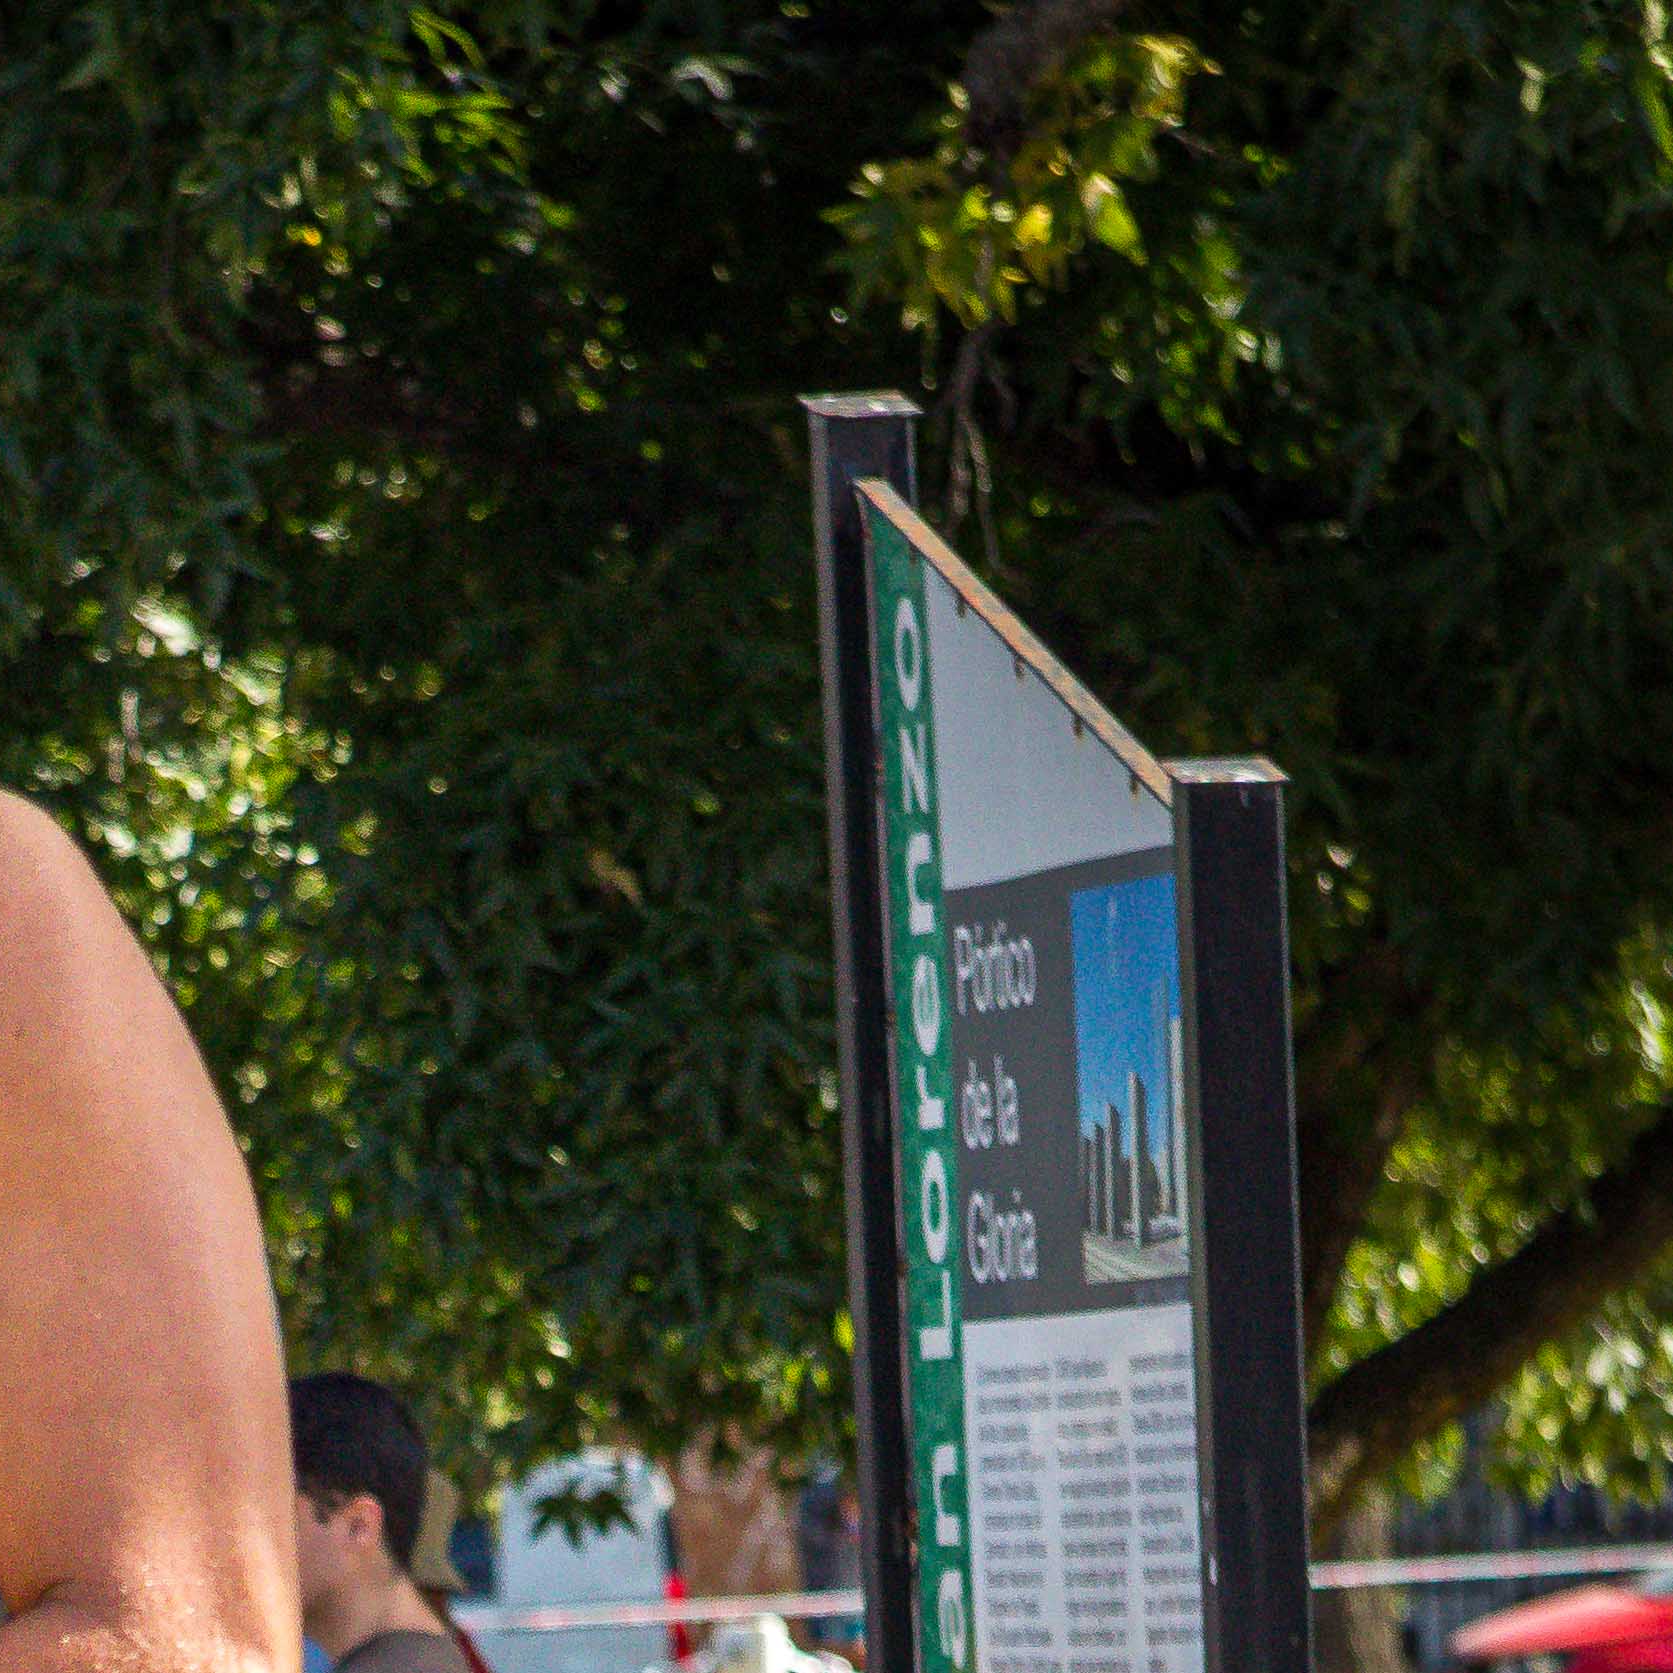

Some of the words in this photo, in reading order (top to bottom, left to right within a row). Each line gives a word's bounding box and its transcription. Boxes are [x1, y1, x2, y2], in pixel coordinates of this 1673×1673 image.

[894, 597, 954, 1360] Lorenzo
[961, 1057, 993, 1150] de
[994, 1054, 1020, 1146] la
[967, 1189, 1039, 1284] Gloria
